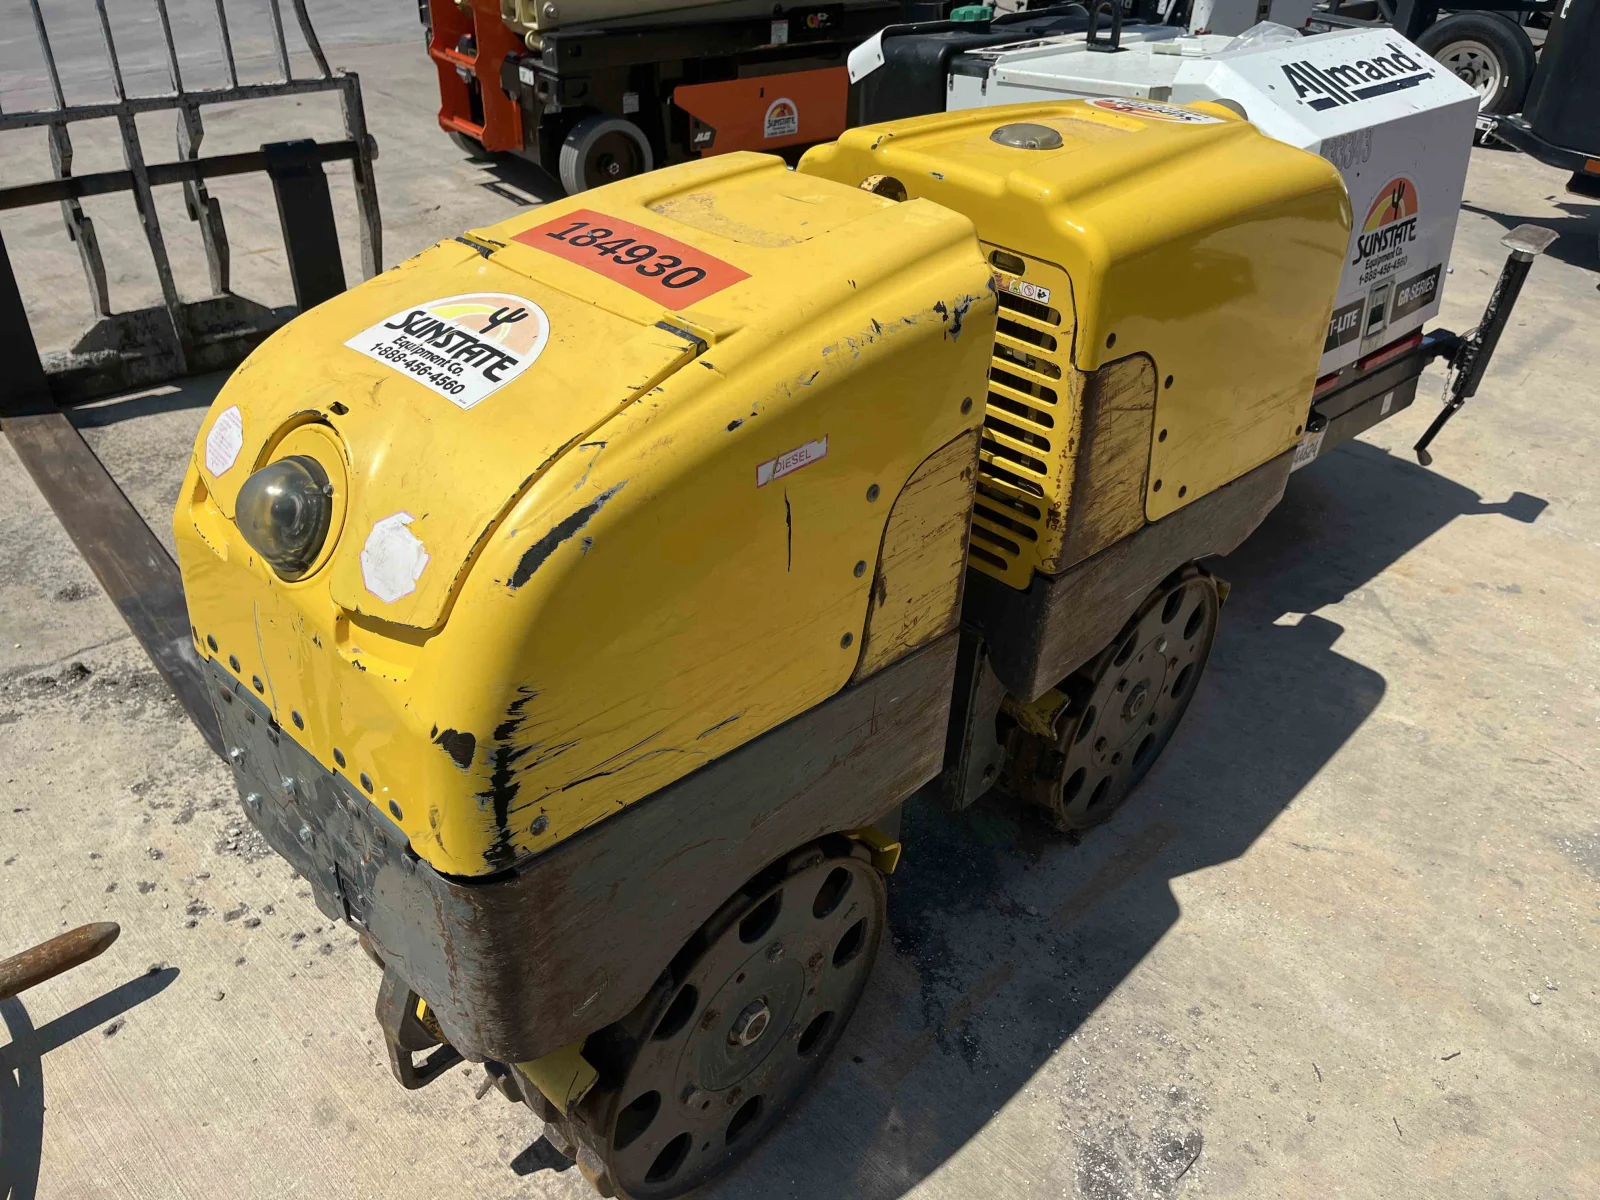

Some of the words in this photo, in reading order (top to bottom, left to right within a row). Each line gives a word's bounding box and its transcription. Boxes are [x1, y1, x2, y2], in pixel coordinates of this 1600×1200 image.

[1281, 43, 1423, 105] Allmand
[694, 131, 711, 142] JLG
[545, 221, 707, 289] 184930
[1352, 217, 1417, 266] SUNSTATE
[1365, 248, 1396, 271] Equipment
[1358, 255, 1408, 286] 1-888-456-4560
[1398, 274, 1436, 307] GR-SERIES
[384, 310, 519, 383] SUNSTATE
[392, 335, 452, 368] Equipment
[447, 362, 464, 377] Co.
[370, 342, 465, 395] 1-888-456-4560
[774, 448, 811, 474] DIESEL
